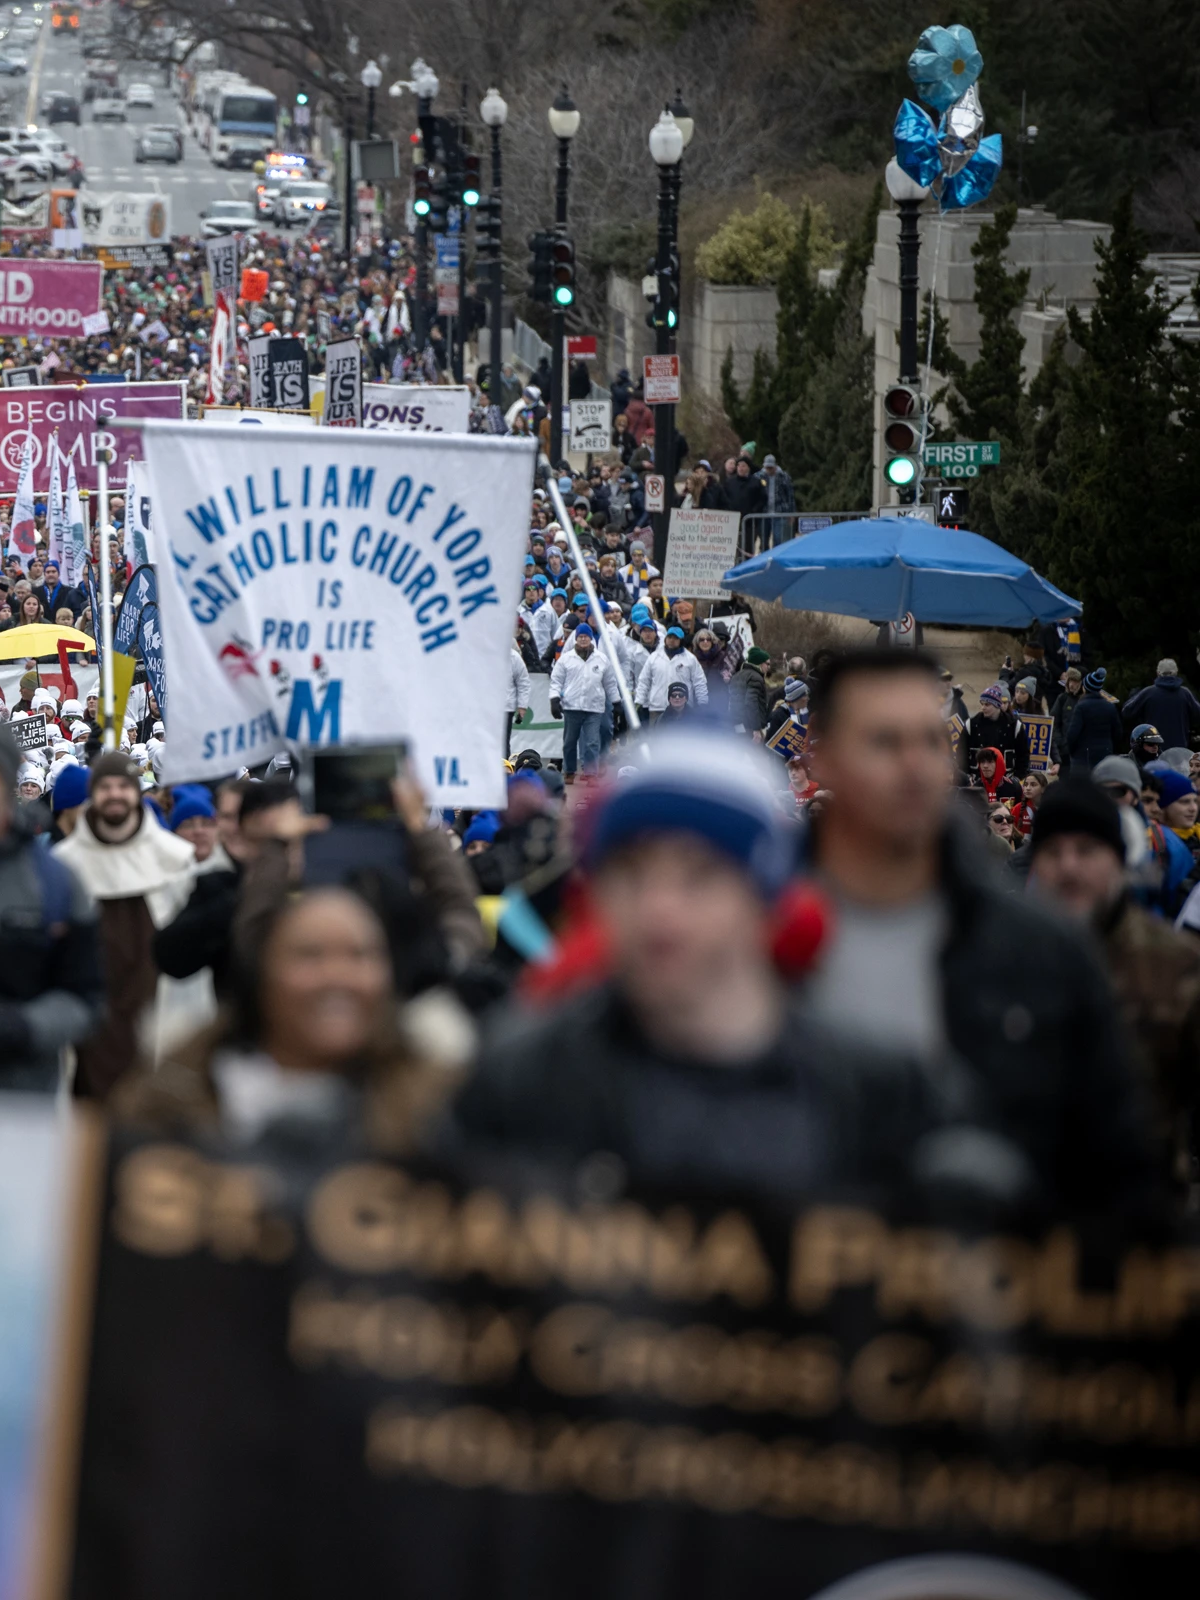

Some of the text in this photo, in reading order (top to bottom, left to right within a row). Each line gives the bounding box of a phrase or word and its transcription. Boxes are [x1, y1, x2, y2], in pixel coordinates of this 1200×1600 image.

[214, 257, 234, 276] IS
[274, 374, 304, 408] IS
[330, 374, 355, 401] IS
[7, 398, 118, 424] BEGINS
[577, 404, 606, 415] STOP
[585, 439, 607, 449] RED
[981, 445, 992, 453] ST
[924, 445, 978, 463] FIRST
[943, 464, 978, 477] 100
[676, 511, 730, 524] Make America
[669, 533, 686, 542] Good
[688, 533, 695, 542] to
[680, 523, 724, 535] good again
[185, 465, 499, 619] WILLIAM OF YORK
[189, 519, 460, 654] CATHOLIC CHURCH
[316, 578, 345, 609] IS
[121, 613, 135, 635] FOR
[116, 627, 131, 646] LIFE
[261, 617, 376, 651] PRO LIFE
[22, 719, 43, 731] THE
[434, 756, 469, 787] VA.
